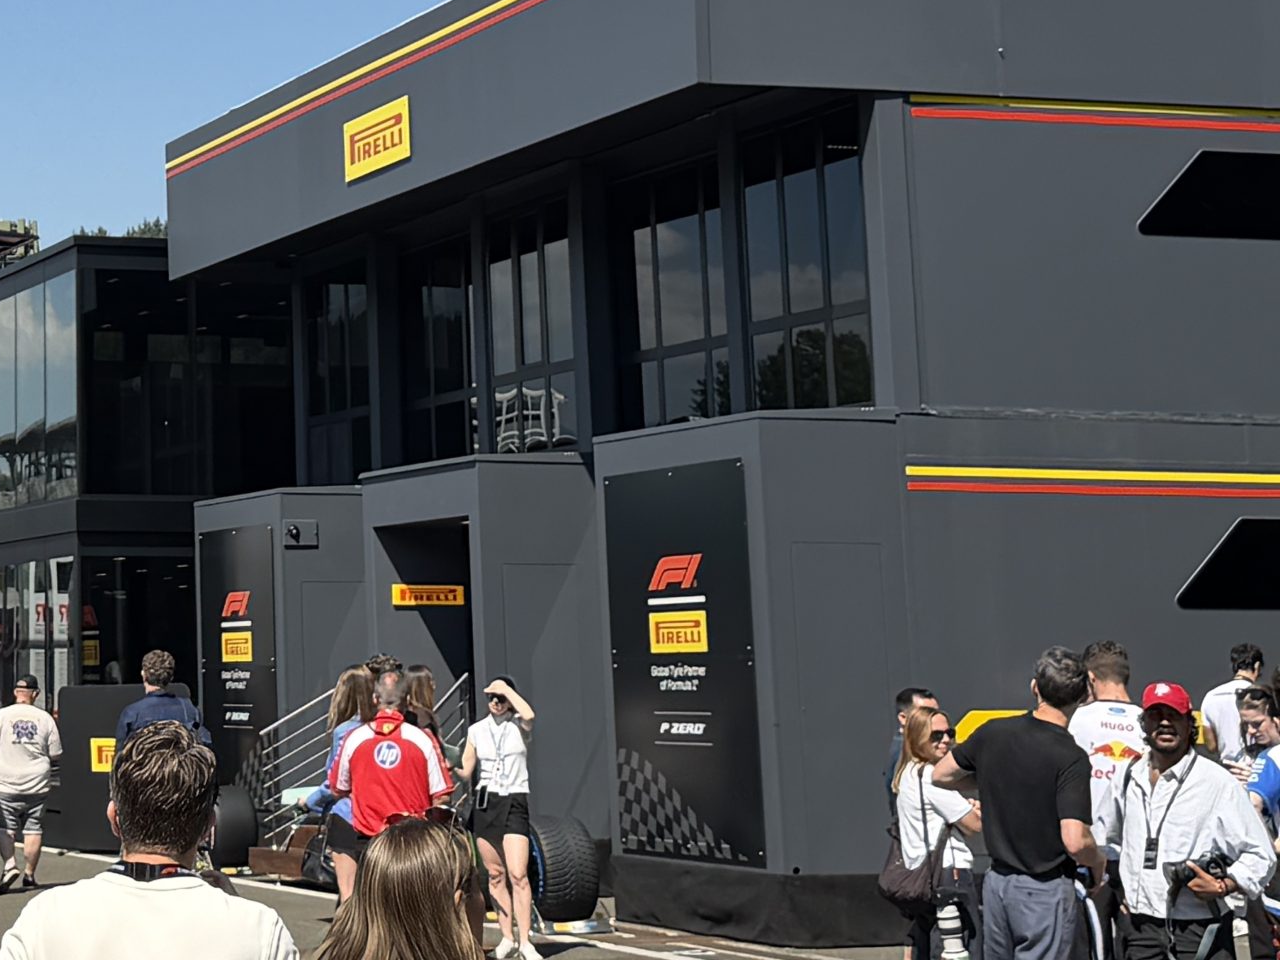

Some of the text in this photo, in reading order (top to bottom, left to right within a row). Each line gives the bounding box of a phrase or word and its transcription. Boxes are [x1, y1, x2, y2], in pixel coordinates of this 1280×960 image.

[349, 112, 403, 166] PIRELLI
[648, 553, 702, 591] F1
[222, 591, 250, 617] F1
[400, 587, 457, 602] PIRELLI
[655, 620, 701, 645] PIRELLI
[660, 722, 670, 734] P
[1100, 721, 1135, 732] HUGO
[1091, 764, 1117, 781] ed
